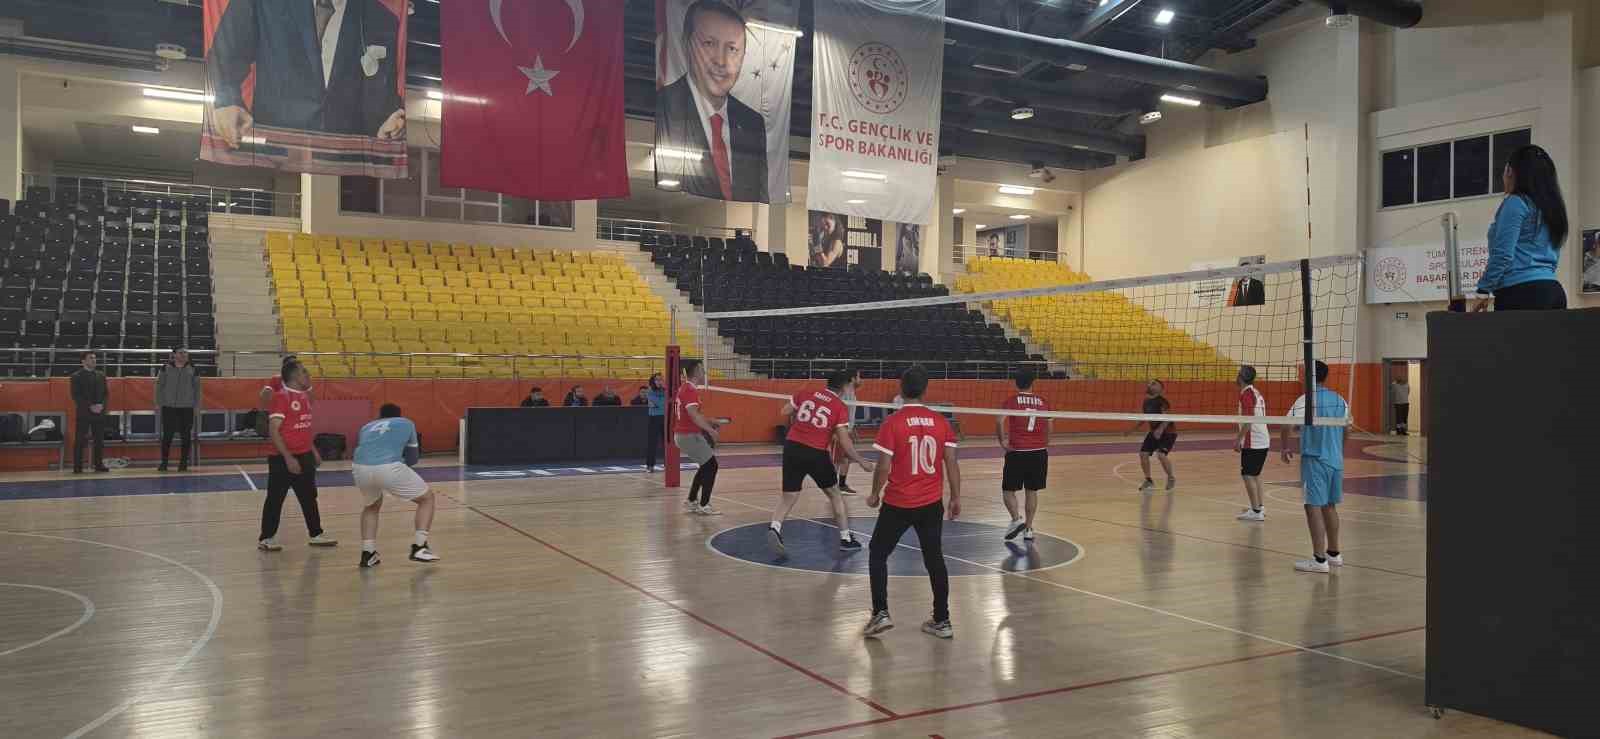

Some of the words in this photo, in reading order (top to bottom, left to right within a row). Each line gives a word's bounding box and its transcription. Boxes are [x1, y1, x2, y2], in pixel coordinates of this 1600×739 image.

[819, 113, 843, 130] T.C.
[848, 119, 911, 142] GENÇLİK
[916, 131, 933, 146] VE
[818, 134, 854, 152] SPOR
[858, 140, 933, 166] BAKANLIĞI
[368, 420, 392, 434] 4
[797, 400, 832, 429] 65
[1025, 408, 1037, 432] 7
[908, 434, 937, 475] 10
